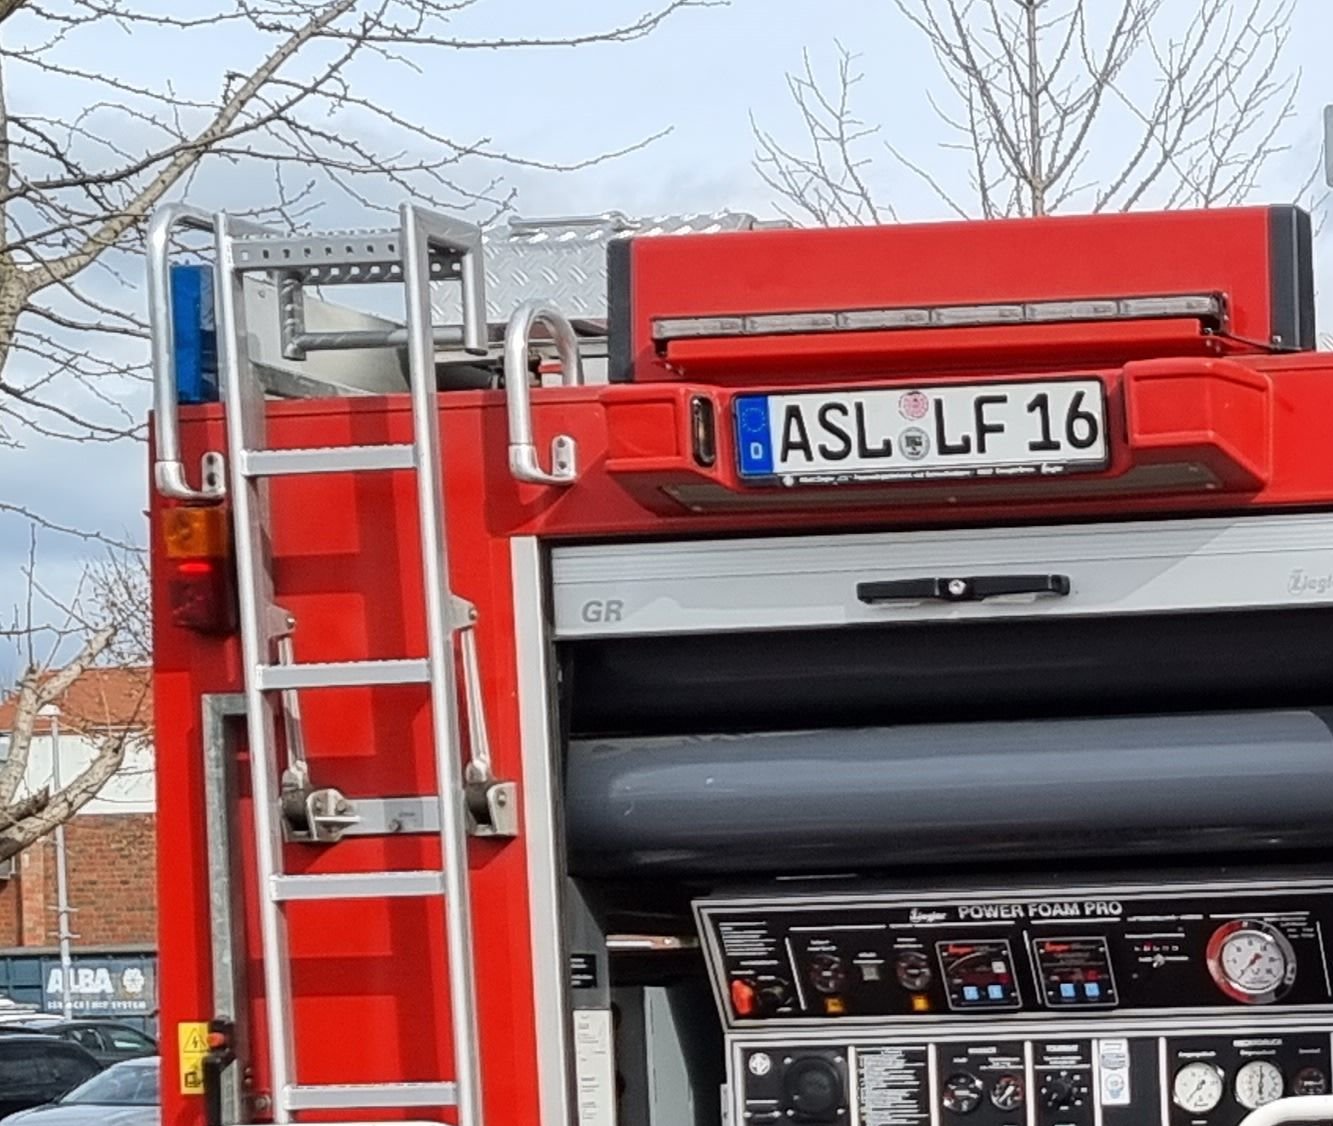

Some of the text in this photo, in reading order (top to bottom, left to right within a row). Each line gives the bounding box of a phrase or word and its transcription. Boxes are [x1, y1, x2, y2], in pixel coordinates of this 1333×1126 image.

[780, 390, 1099, 463] ASL LF 16
[749, 441, 762, 460] D
[582, 600, 624, 622] GR
[958, 904, 1024, 919] POWER
[1028, 903, 1080, 917] FOAM
[1084, 901, 1123, 915] PRO
[46, 968, 114, 993] ALBA
